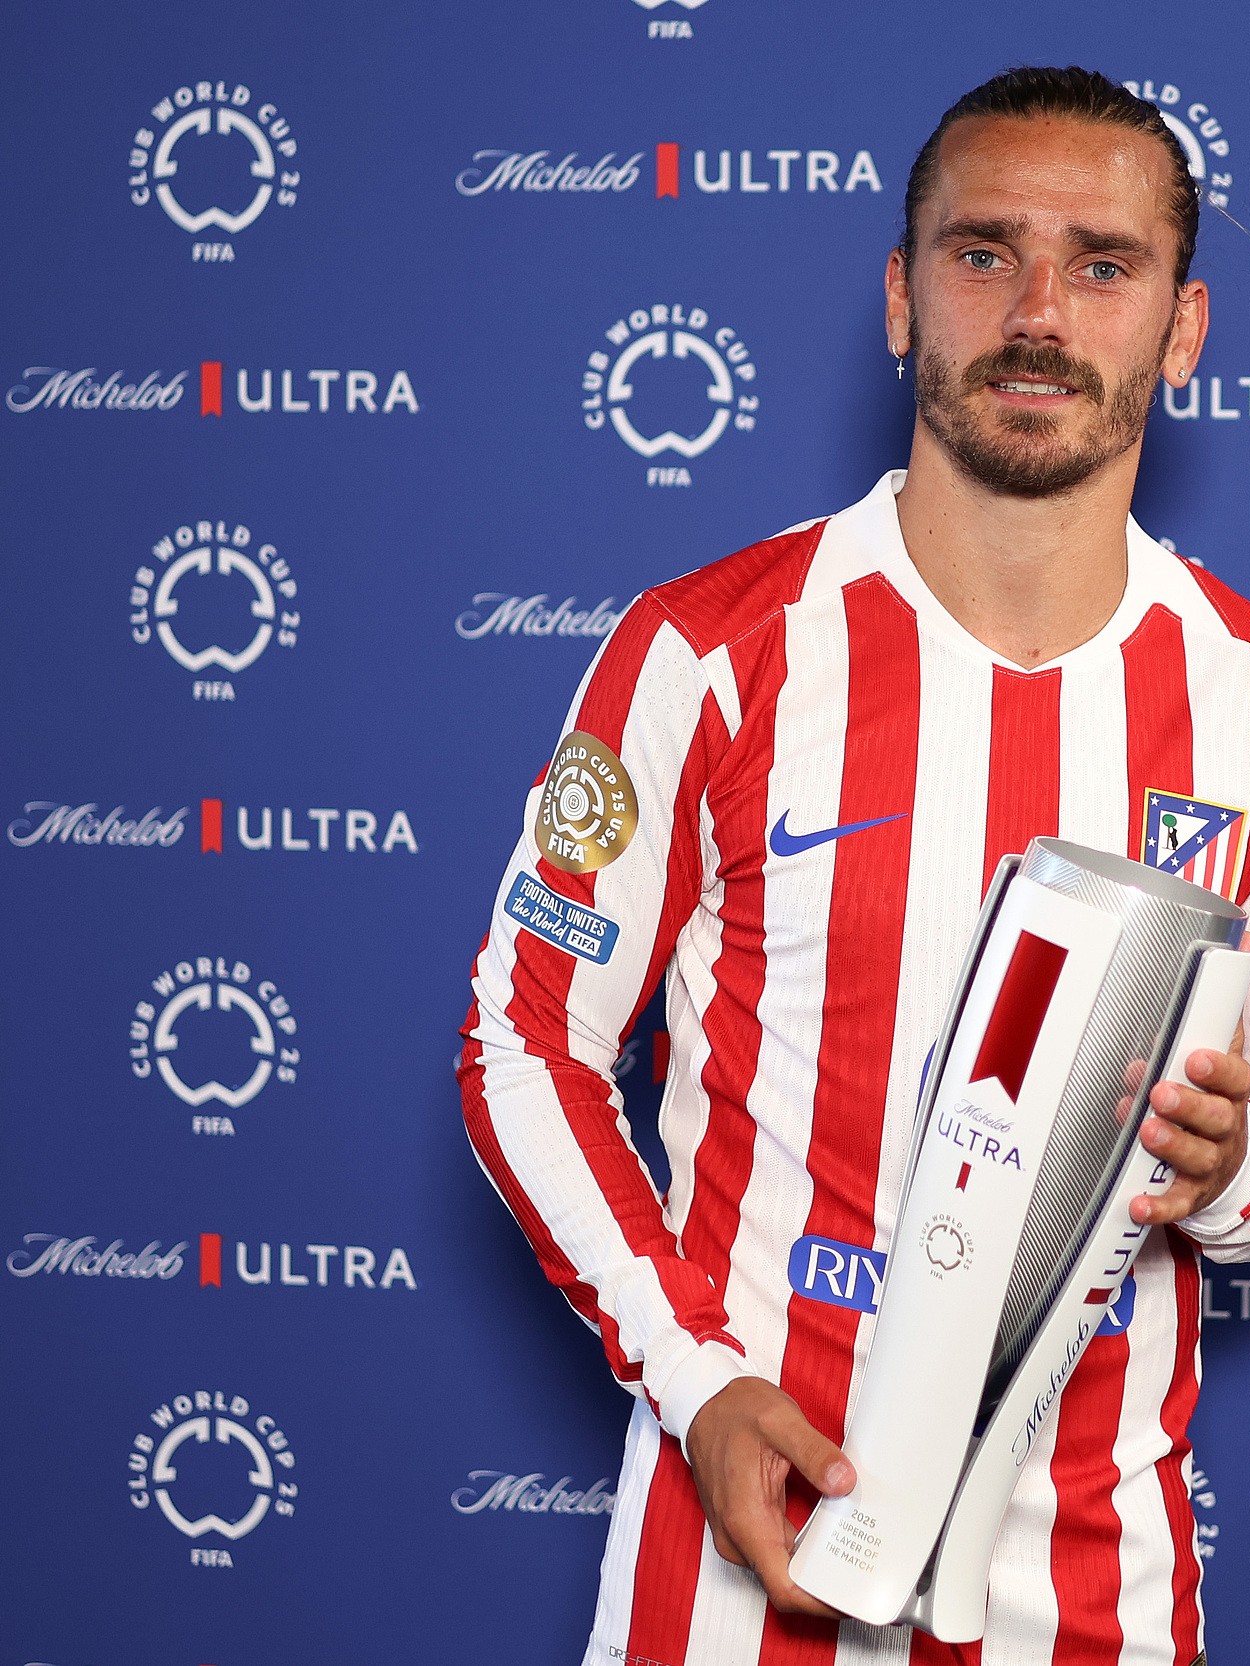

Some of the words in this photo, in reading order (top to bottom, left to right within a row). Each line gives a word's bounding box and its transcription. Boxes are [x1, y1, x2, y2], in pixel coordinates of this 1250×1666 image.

[648, 20, 693, 38] FIFA
[130, 129, 154, 205] CLUB
[152, 81, 250, 122] WORLD
[259, 104, 297, 156] CUP
[278, 172, 300, 205] 25
[1186, 102, 1230, 157] CUP
[455, 149, 645, 196] Michelob
[694, 150, 883, 193] ULTRA
[1207, 172, 1233, 208] 25
[193, 243, 235, 261] FIFA
[583, 351, 609, 429] CLUB
[606, 304, 708, 344] WORLD
[715, 327, 755, 381] CUP
[735, 396, 759, 429] 25
[5, 366, 188, 413] Michelob
[238, 369, 419, 413] ULTRA
[647, 467, 691, 486] FIFA
[131, 567, 155, 643] CLUB
[153, 521, 251, 561] WORLD
[259, 544, 297, 598] CUP
[278, 612, 300, 645] 25
[455, 592, 624, 641] Michelo
[193, 681, 235, 700] FIFA
[553, 746, 587, 776] WORLD
[590, 755, 617, 785] CUP
[543, 780, 555, 826] CLUB
[611, 789, 626, 812] 25
[7, 801, 189, 847] Michelob
[238, 807, 419, 853] ULTRA
[595, 817, 624, 849] USA
[547, 832, 586, 864] FIFA
[511, 896, 531, 918] the
[529, 906, 569, 942] World
[519, 878, 564, 919] FOOTBALL
[566, 907, 608, 937] UNITES
[570, 933, 596, 952] FIFA
[153, 957, 251, 996] WORLD
[259, 981, 297, 1034] CUP
[130, 1002, 155, 1077] CLUB
[277, 1048, 299, 1082] 25
[193, 1116, 235, 1134] FIFA
[953, 1098, 1016, 1134] Michelob
[937, 1111, 1022, 1171] ULTRA
[919, 1222, 930, 1247] CLUB
[932, 1214, 962, 1228] WORLD
[964, 1232, 974, 1253] CUP
[6, 1233, 187, 1280] Michelob
[237, 1241, 417, 1290] ULTRA
[930, 1269, 943, 1280] FIFA
[151, 1391, 249, 1428] WORLD
[1011, 1316, 1090, 1468] Michelob
[256, 1416, 295, 1467] CUP
[128, 1434, 153, 1508] CLUB
[1192, 1468, 1217, 1509] UP
[275, 1483, 298, 1515] 25
[838, 1519, 882, 1547] SUPERIOR
[851, 1509, 877, 1529] 2025
[191, 1549, 233, 1567] FIFA
[824, 1541, 842, 1556] THE
[841, 1552, 875, 1573] MATCH
[832, 1530, 862, 1553] PLAYER
[864, 1549, 879, 1559] OF
